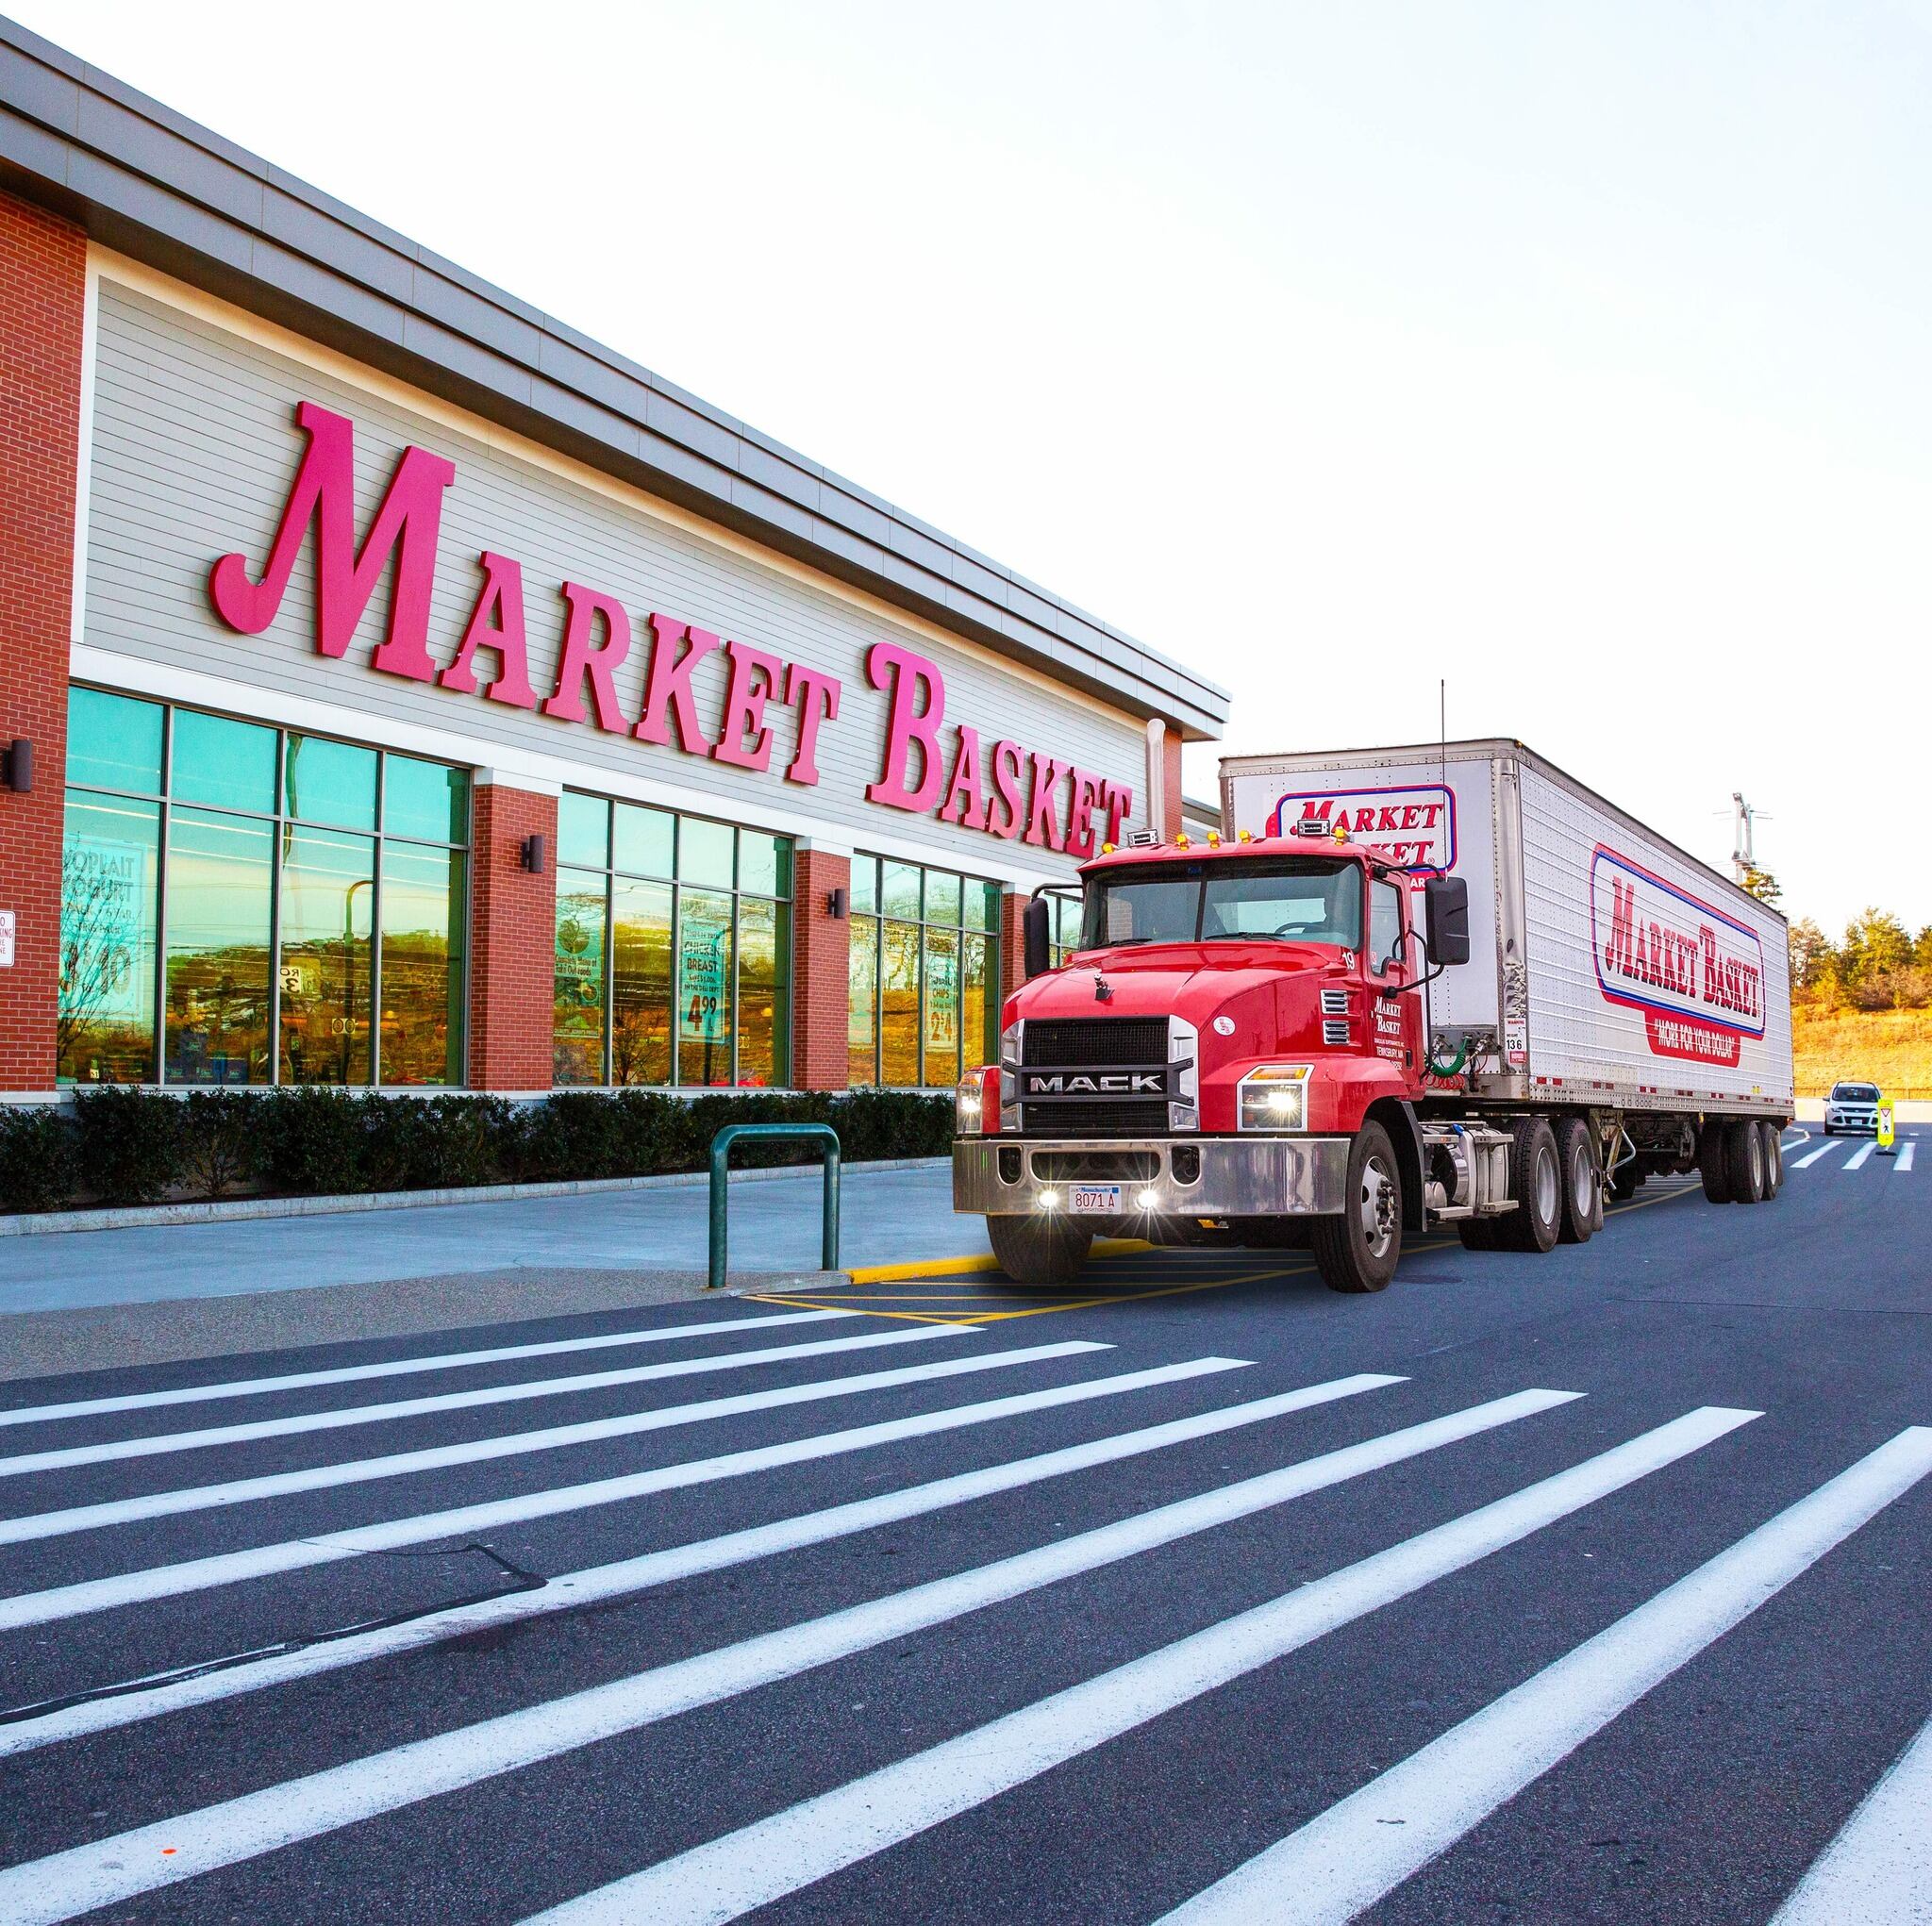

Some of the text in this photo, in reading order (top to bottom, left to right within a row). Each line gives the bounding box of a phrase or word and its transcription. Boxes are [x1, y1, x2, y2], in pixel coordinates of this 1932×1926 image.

[208, 401, 1132, 859] MARKET BASKET
[1605, 875, 1758, 1019] MARKET BASKET
[687, 957, 718, 973] BREAST
[1341, 952, 1355, 971] 19
[1374, 995, 1402, 1018] MARKET
[1375, 1014, 1401, 1036] BASKET
[1030, 1074, 1162, 1092] MACK
[1075, 1192, 1115, 1207] 8071 A
